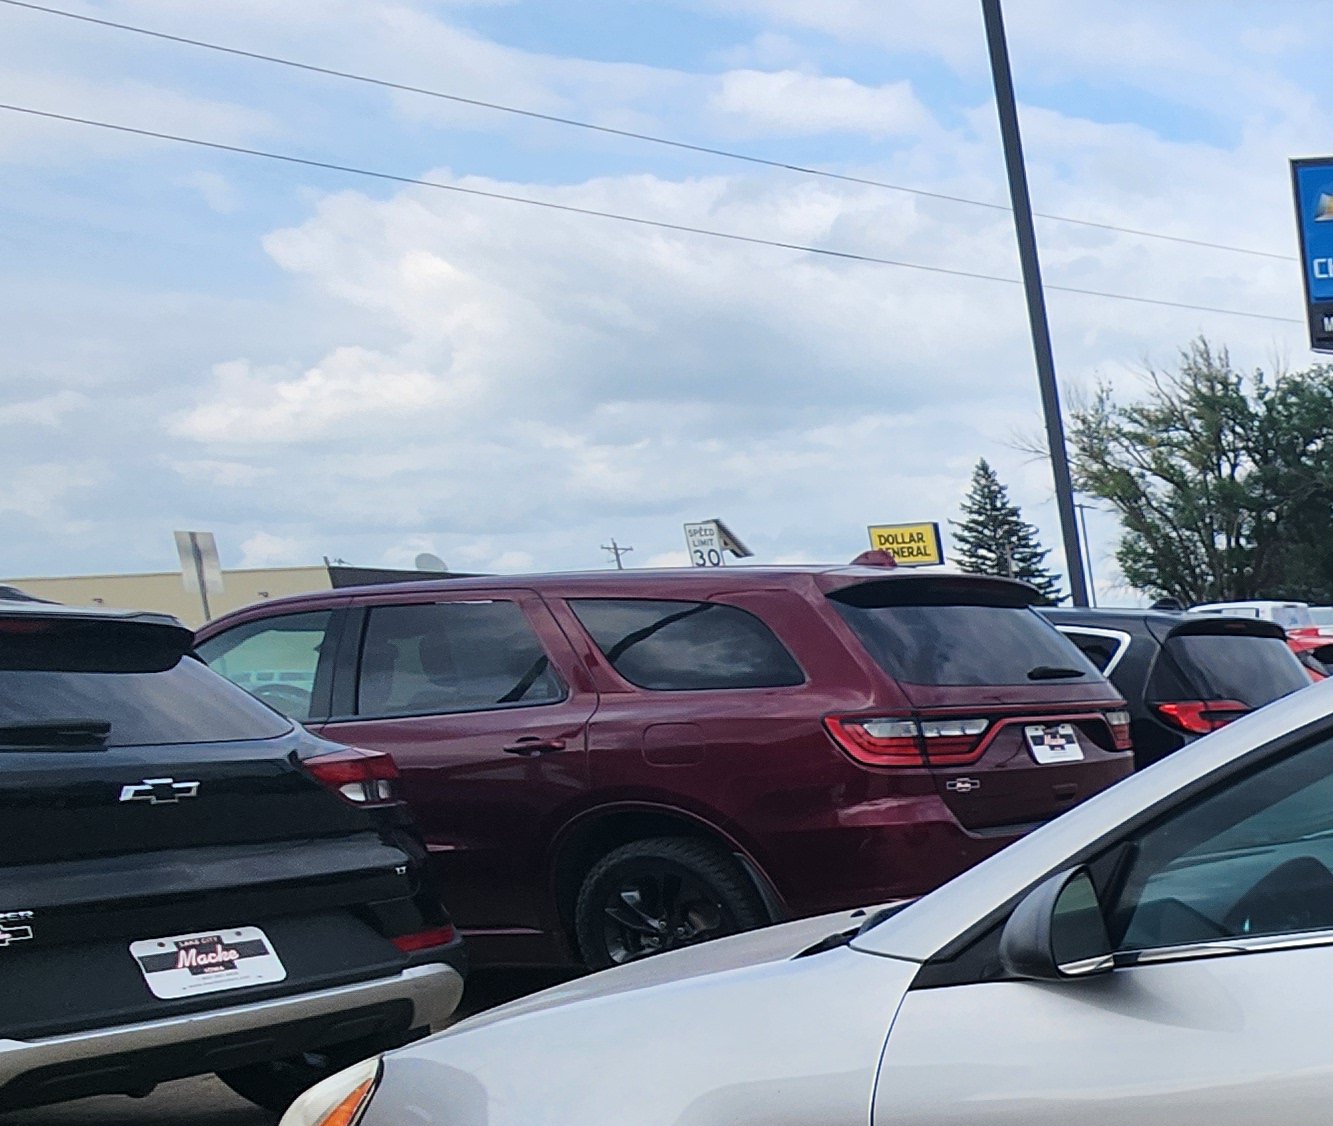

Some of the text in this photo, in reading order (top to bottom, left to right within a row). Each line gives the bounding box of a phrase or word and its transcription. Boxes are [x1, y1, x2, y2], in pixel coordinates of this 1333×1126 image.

[688, 527, 715, 537] SPEED
[692, 538, 714, 547] LIMIT
[877, 532, 925, 546] DOLLAR
[693, 548, 720, 567] 30
[882, 545, 931, 558] NERAL
[177, 944, 240, 969] Macke
